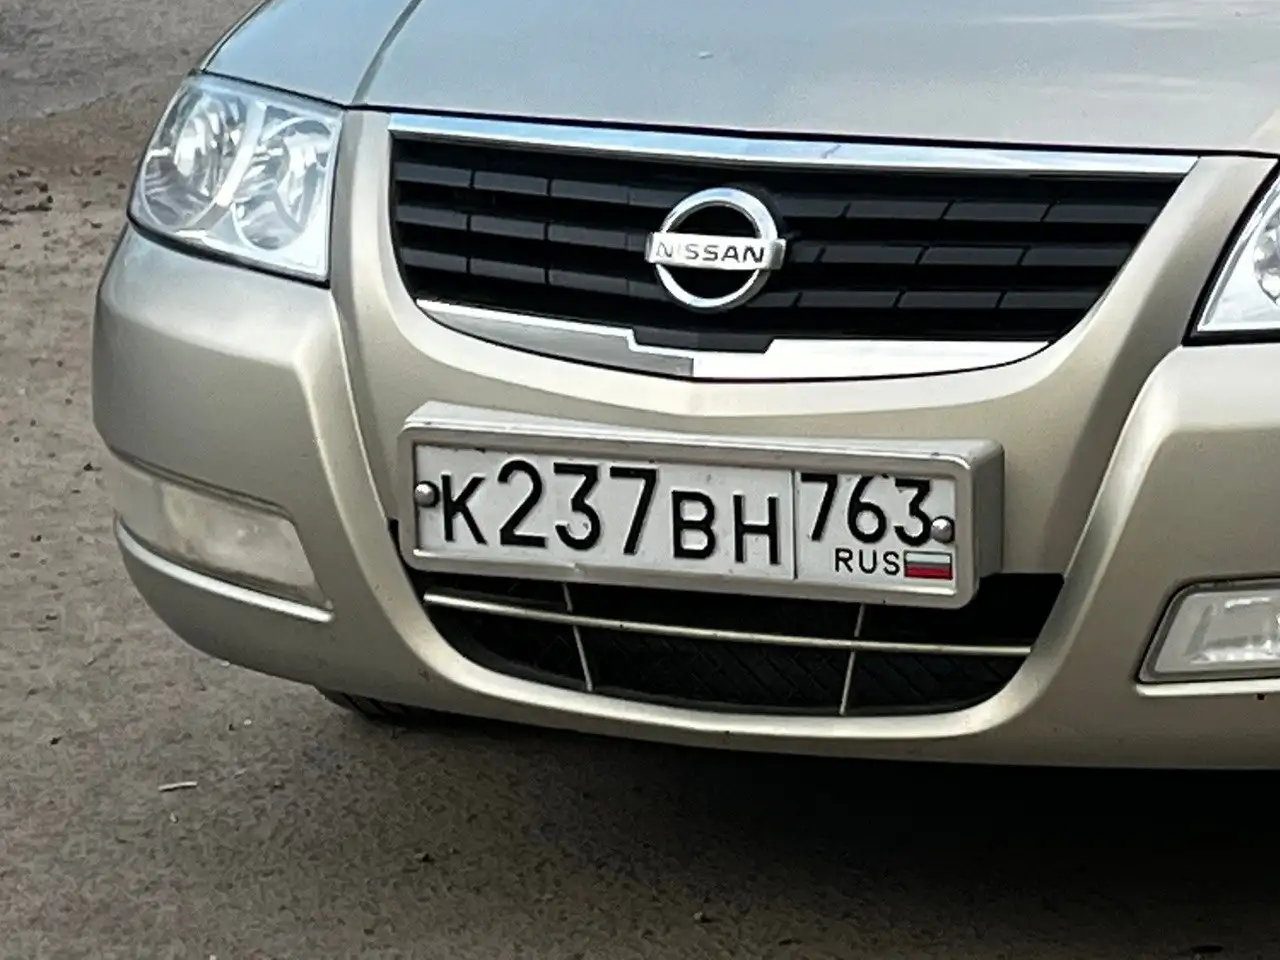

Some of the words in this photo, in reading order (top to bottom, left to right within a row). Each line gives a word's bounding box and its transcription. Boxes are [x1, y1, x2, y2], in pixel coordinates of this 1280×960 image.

[656, 241, 764, 263] NISSAN
[801, 472, 933, 547] 763
[834, 548, 901, 576] RUS
